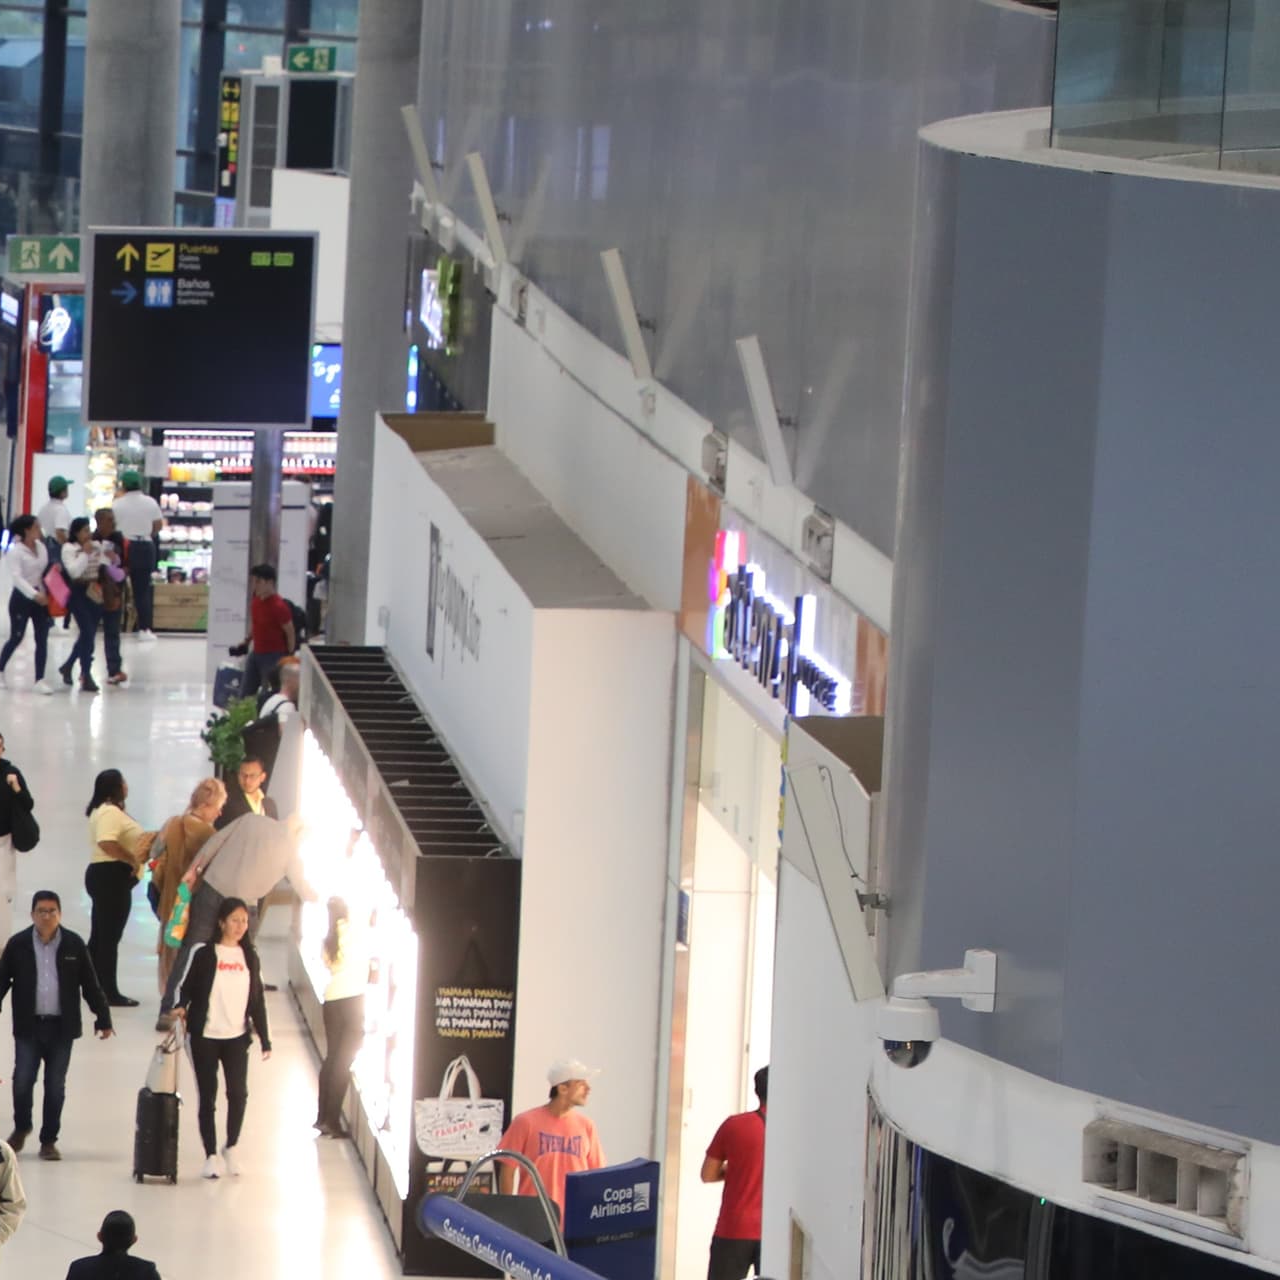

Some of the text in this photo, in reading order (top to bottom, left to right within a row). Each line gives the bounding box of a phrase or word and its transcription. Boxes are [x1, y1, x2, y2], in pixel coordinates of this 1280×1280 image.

[538, 1131, 583, 1158] EVERLAST
[603, 1185, 633, 1203] Copa
[590, 1201, 633, 1219] Airlines
[443, 1218, 472, 1249] Service
[472, 1234, 499, 1266] Center
